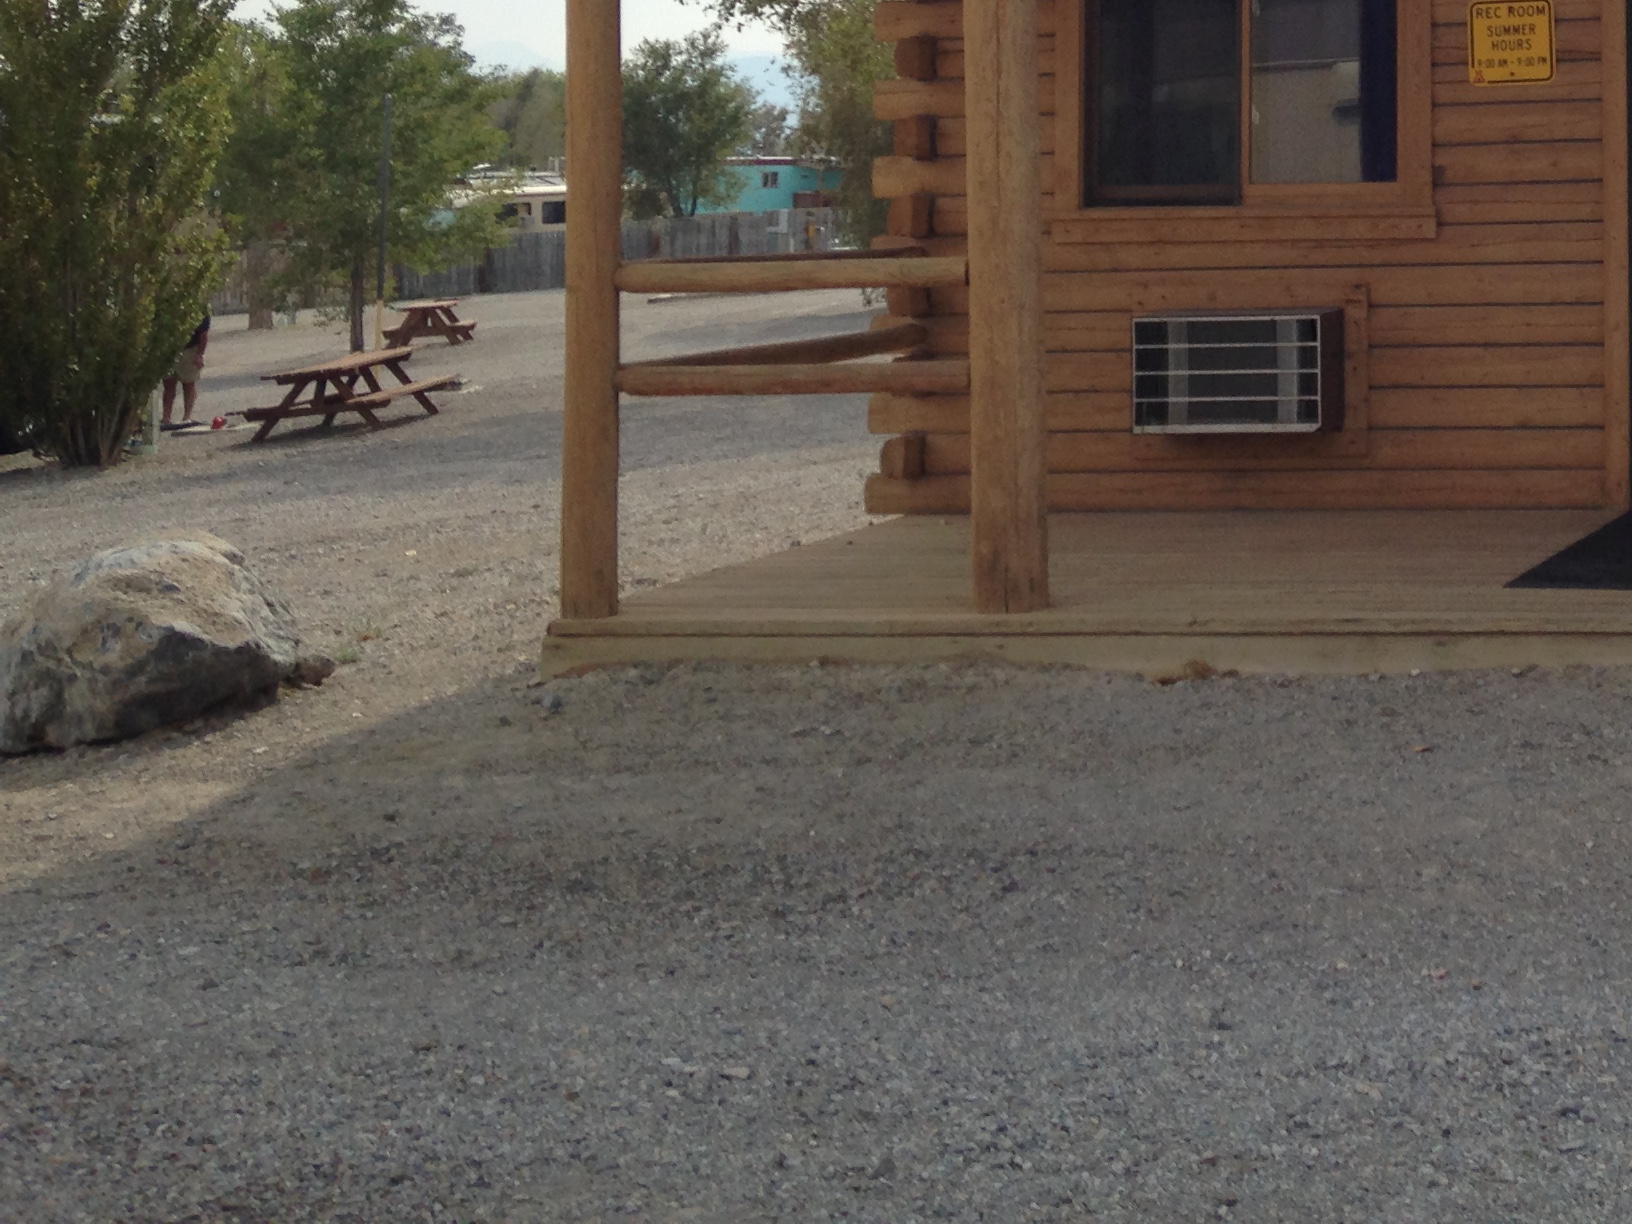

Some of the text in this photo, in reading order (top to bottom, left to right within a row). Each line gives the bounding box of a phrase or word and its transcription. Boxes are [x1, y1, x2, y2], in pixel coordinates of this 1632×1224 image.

[1475, 5, 1545, 19] REC ROOM
[1486, 23, 1536, 37] SUMMER
[1491, 38, 1532, 51] HOURS
[1497, 58, 1508, 68] AM
[1537, 56, 1548, 66] PM
